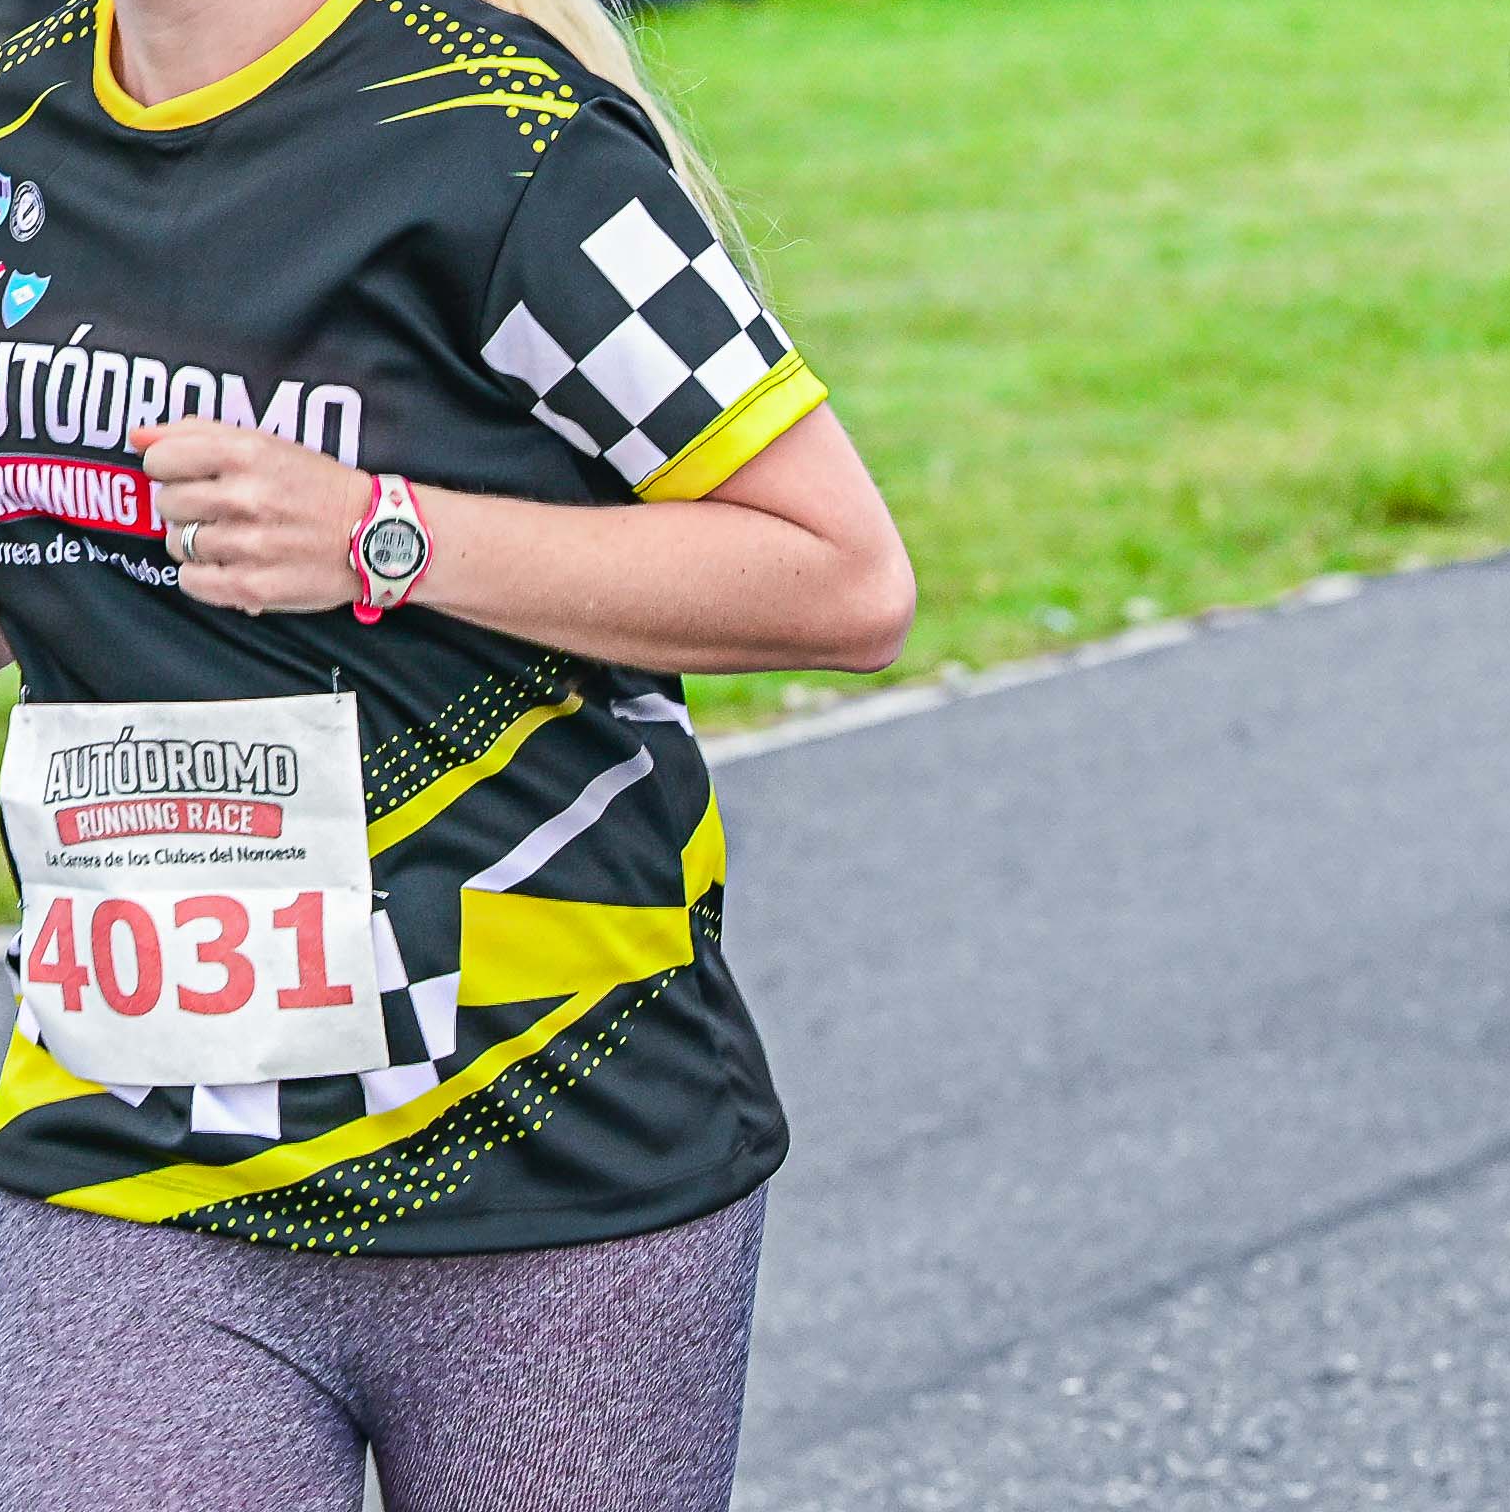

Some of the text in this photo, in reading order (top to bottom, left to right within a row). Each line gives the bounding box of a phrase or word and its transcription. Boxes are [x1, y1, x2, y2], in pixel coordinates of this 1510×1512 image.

[45, 533, 81, 563] de
[43, 726, 299, 804] AUTÓDROMO
[75, 802, 255, 840] RUNNING RACE
[105, 851, 123, 867] de
[128, 849, 150, 866] los
[154, 848, 206, 864] Clubes
[210, 846, 232, 863] del
[238, 846, 307, 862] Noroeste
[28, 891, 354, 1017] 4031
